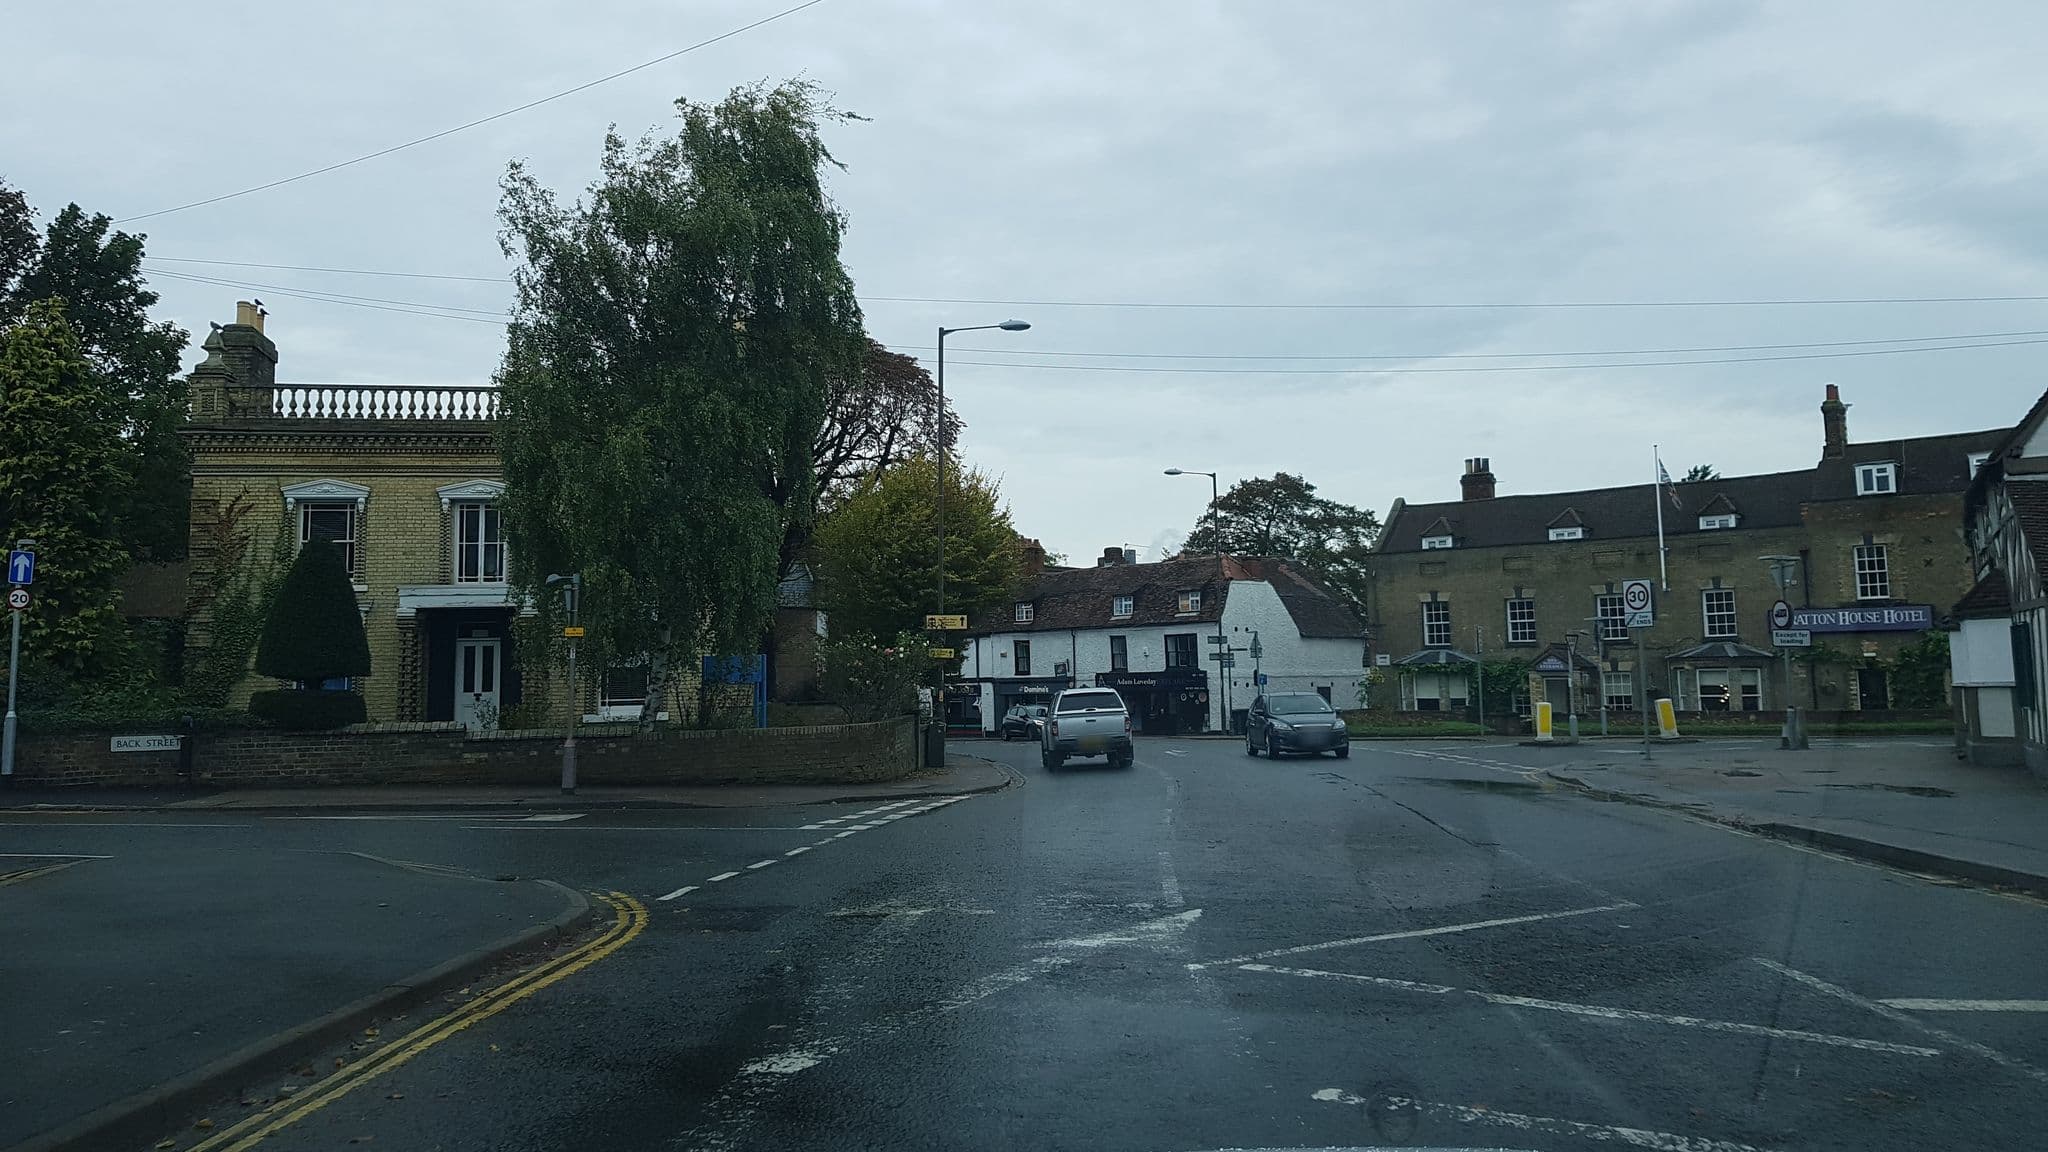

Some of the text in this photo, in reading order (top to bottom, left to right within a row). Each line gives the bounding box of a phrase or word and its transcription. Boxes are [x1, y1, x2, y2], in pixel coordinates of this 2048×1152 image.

[12, 594, 28, 604] 20
[1629, 590, 1646, 602] 30
[1838, 611, 1881, 625] HOUSE
[1884, 610, 1927, 624] HOTEL
[1024, 685, 1049, 693] Domino's
[116, 739, 180, 748] BACK STREET
